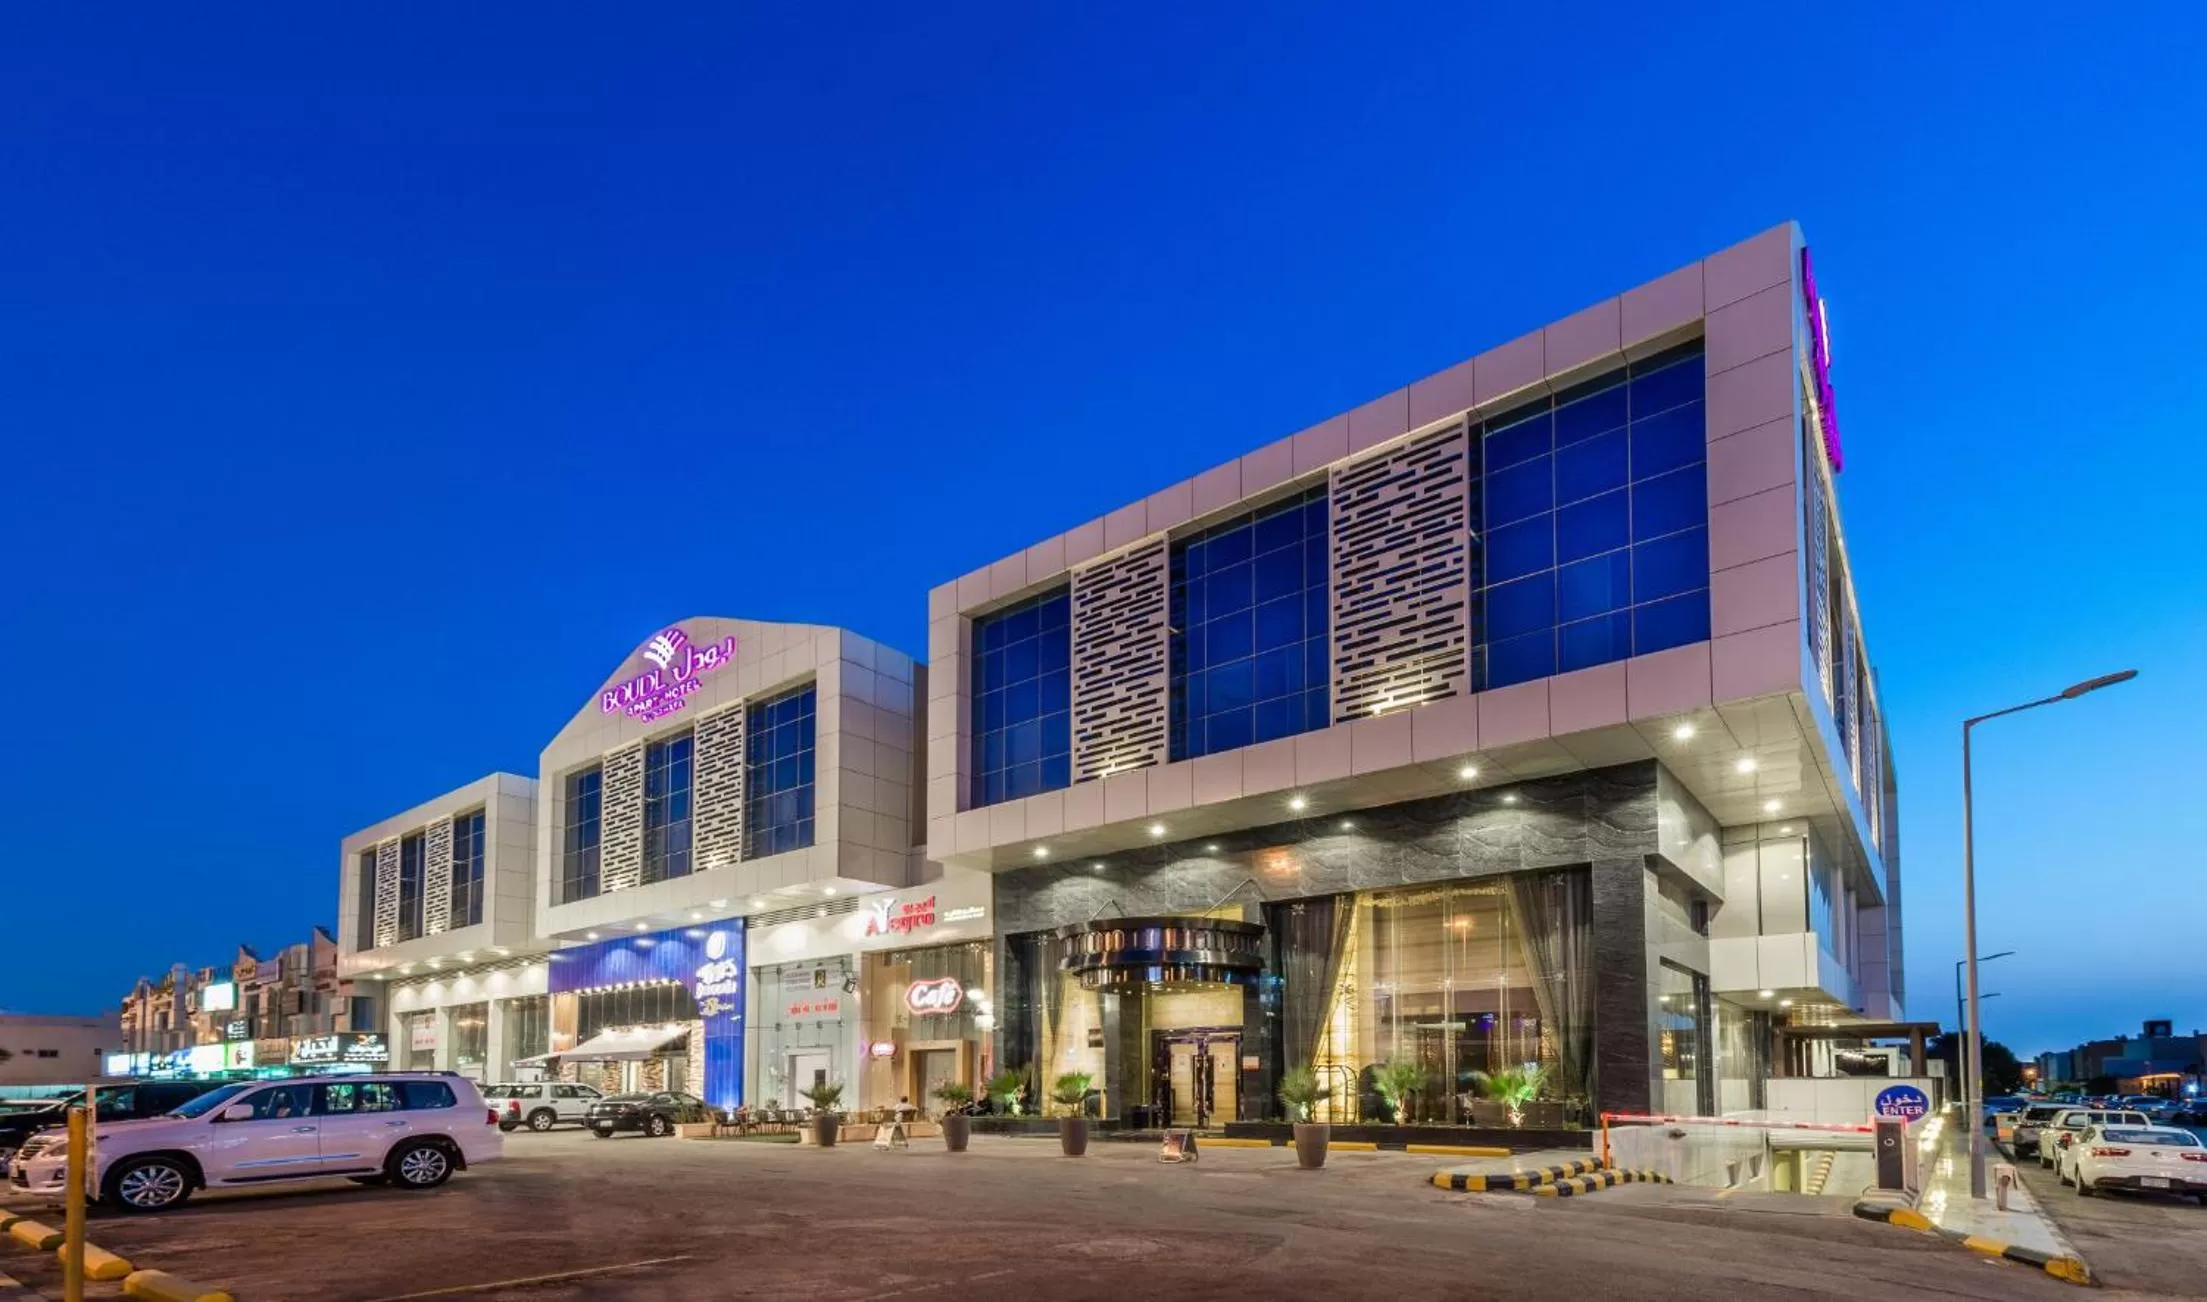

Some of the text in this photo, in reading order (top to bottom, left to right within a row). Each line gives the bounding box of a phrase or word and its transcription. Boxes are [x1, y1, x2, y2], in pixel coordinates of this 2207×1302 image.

[673, 637, 735, 682] بودل
[603, 670, 668, 713] BOUDL
[1880, 1094, 1924, 1107] دخول
[1883, 1106, 1925, 1116] ENTER
